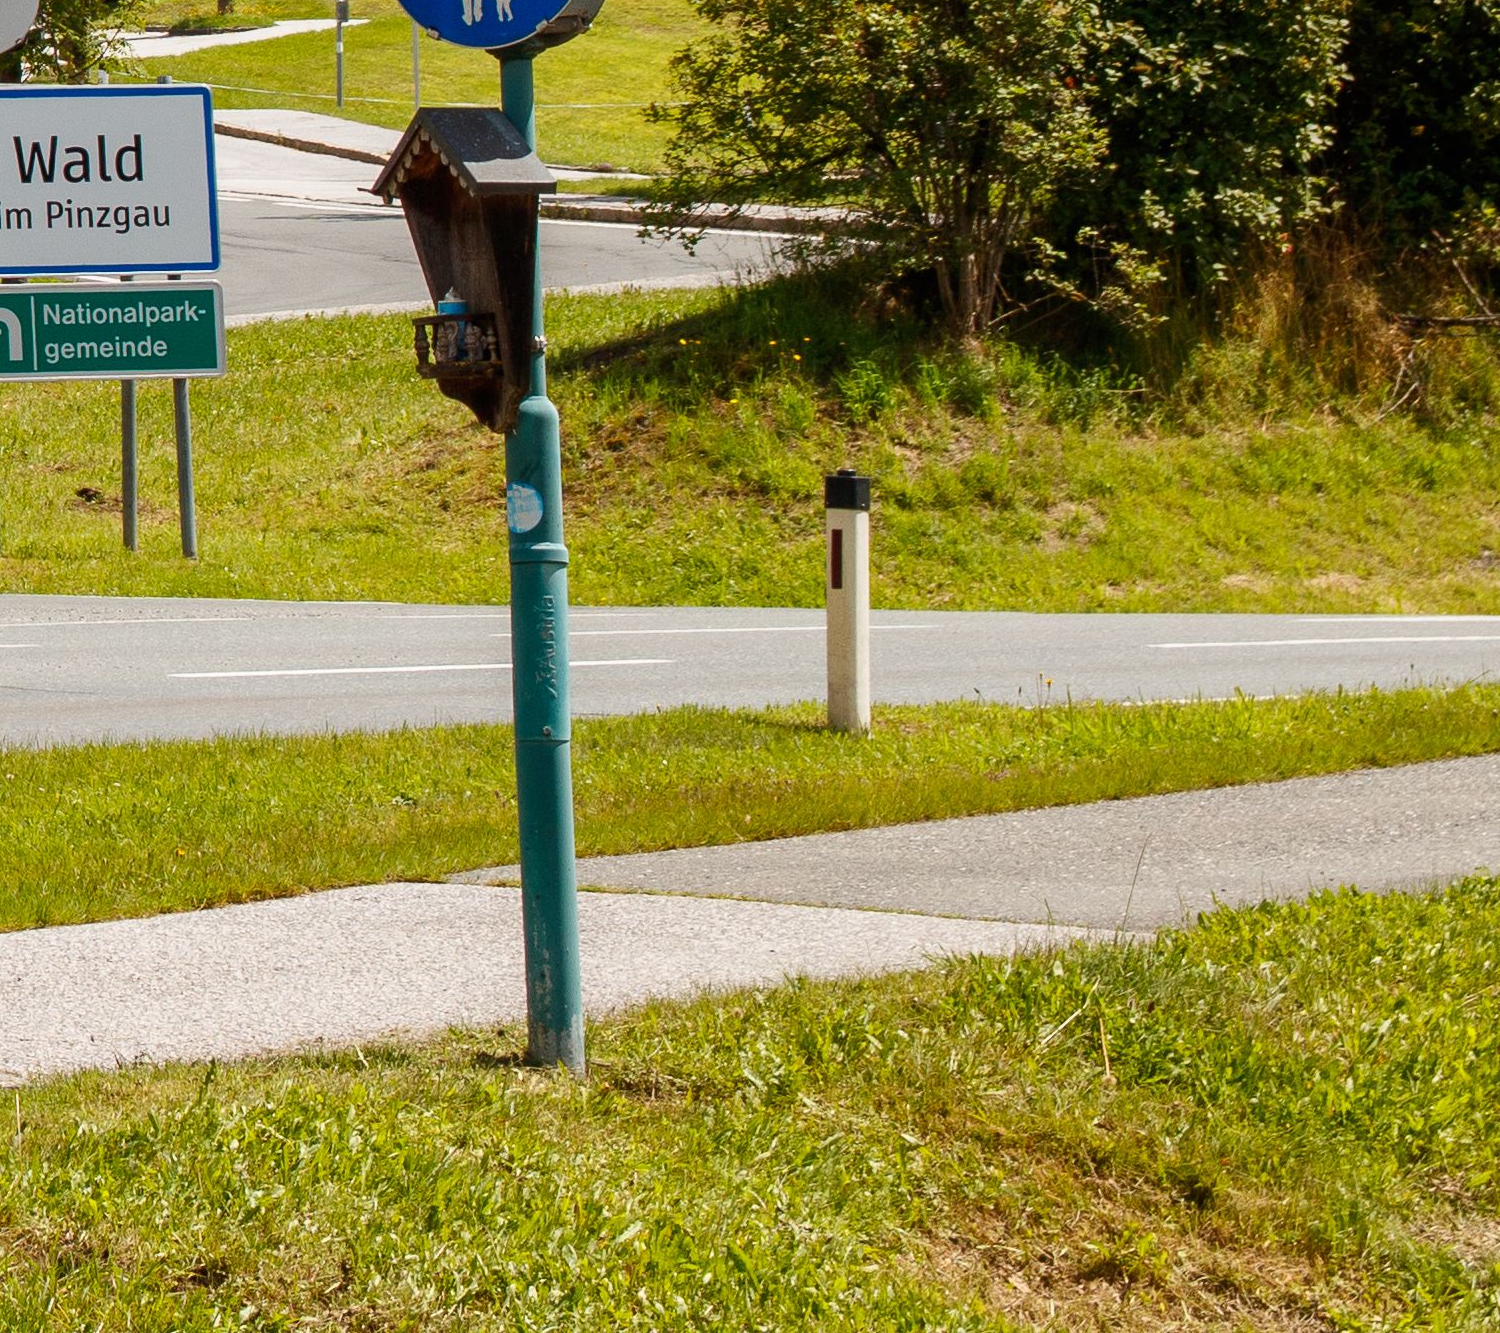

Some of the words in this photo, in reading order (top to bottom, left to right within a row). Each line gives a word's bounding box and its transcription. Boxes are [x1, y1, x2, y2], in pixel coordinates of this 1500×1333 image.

[13, 134, 144, 183] Wald
[46, 198, 171, 234] Pinzgau
[43, 300, 207, 328] Nationalpark-
[45, 336, 168, 364] gemeinde
